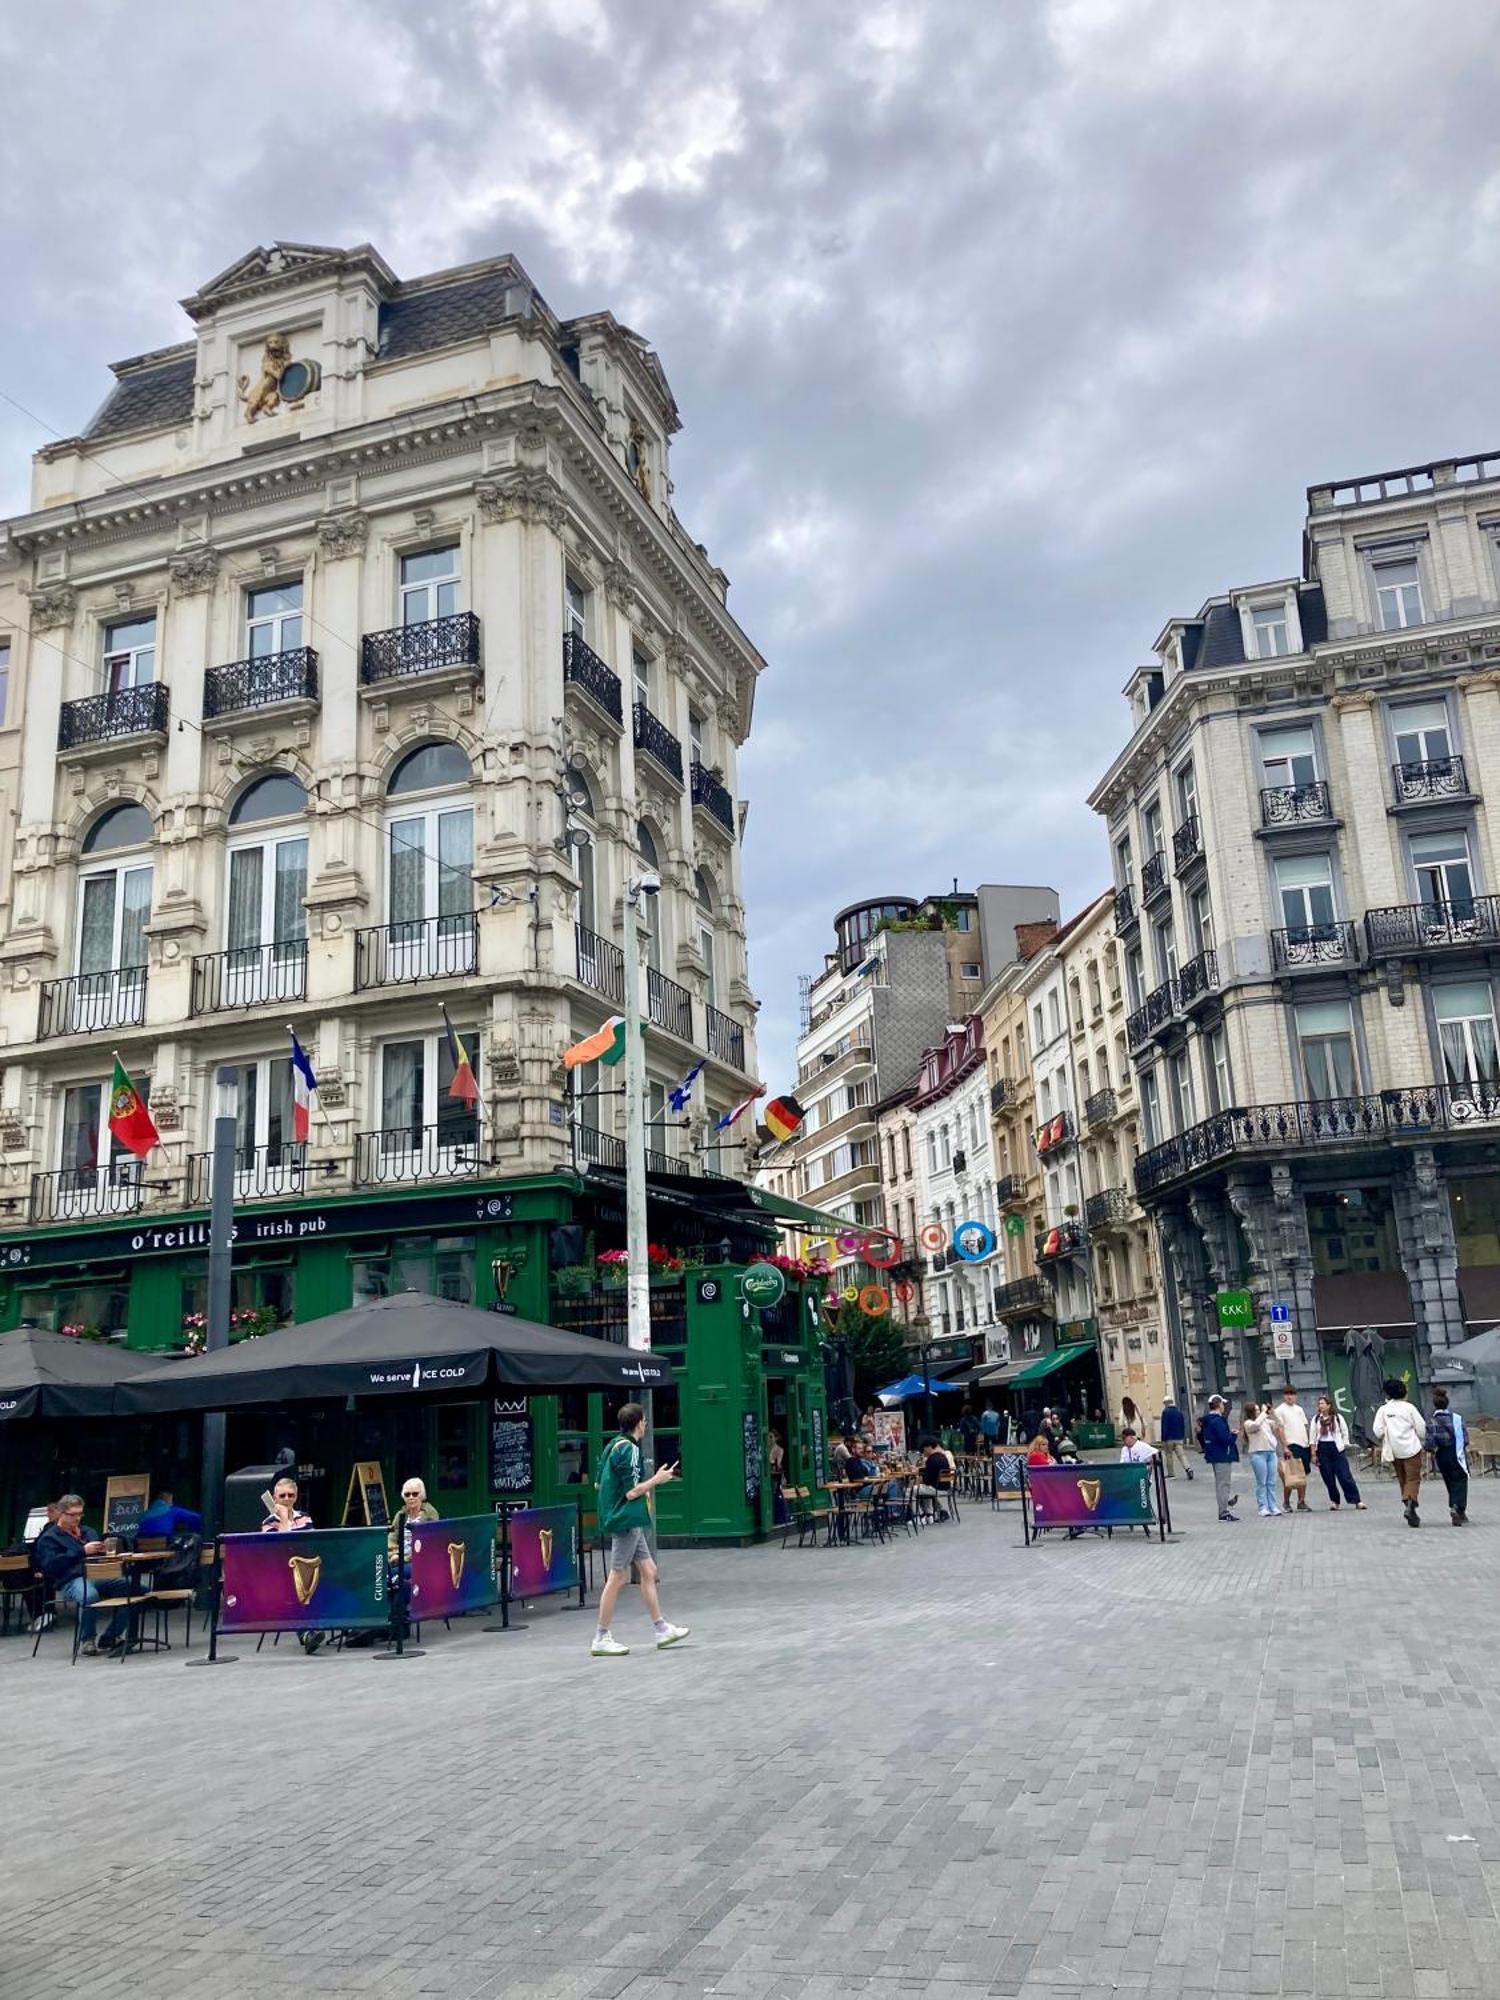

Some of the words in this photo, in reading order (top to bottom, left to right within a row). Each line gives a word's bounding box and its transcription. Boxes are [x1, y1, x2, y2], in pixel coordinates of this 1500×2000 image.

[132, 1223, 238, 1250] o'reills
[257, 1219, 293, 1237] irish
[299, 1216, 326, 1235] pub
[370, 1374, 384, 1383] We
[386, 1373, 411, 1382] serve
[422, 1370, 438, 1379] ICE
[440, 1367, 465, 1378] COLD
[0, 1401, 17, 1410] OLD
[374, 1553, 384, 1601] GUINNESS
